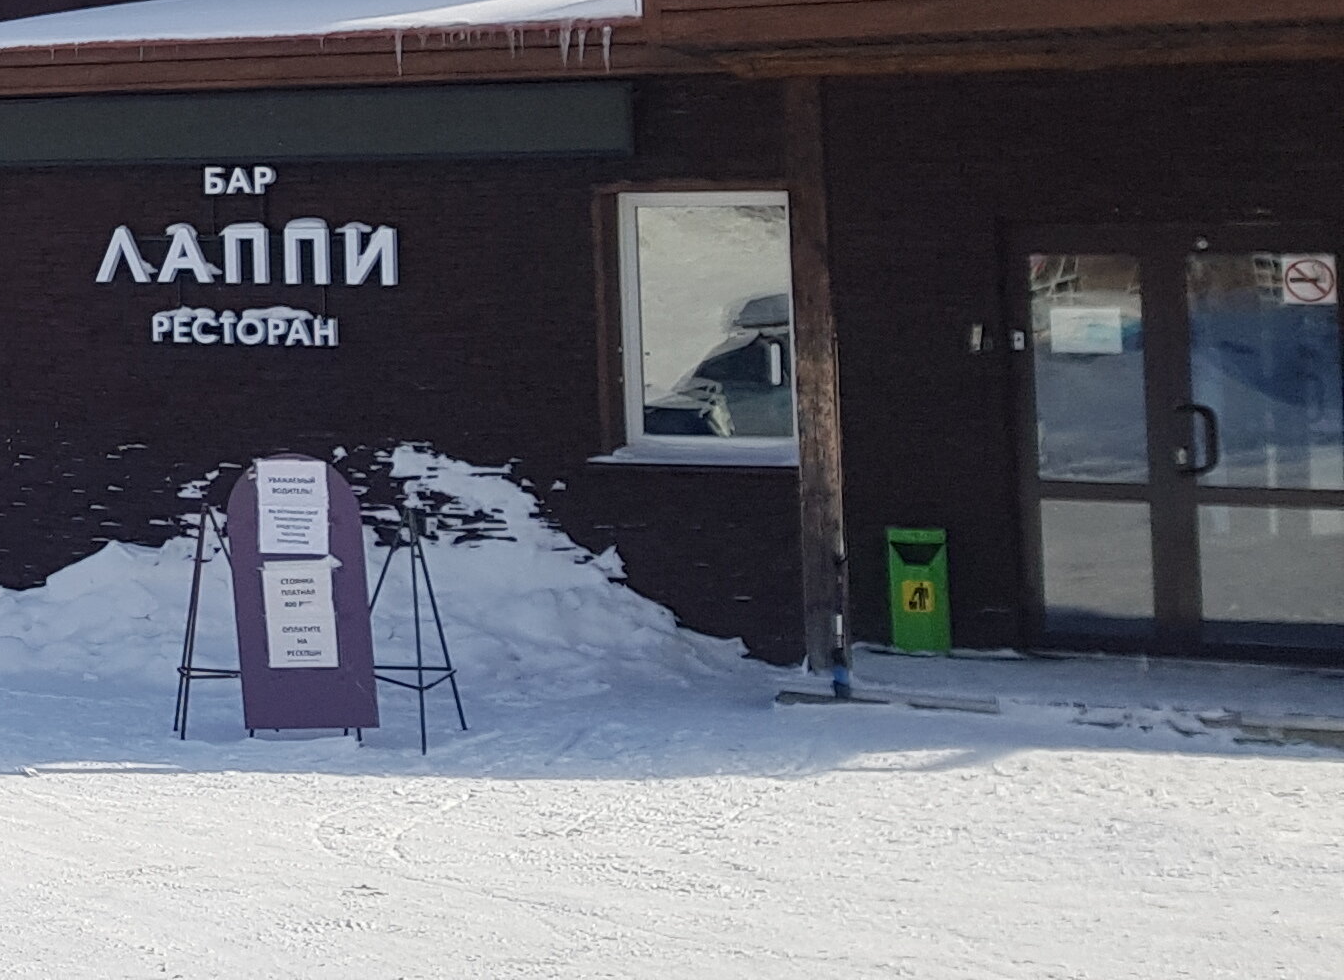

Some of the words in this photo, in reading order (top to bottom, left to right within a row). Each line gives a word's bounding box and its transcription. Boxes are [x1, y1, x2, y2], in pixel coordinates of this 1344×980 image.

[204, 166, 277, 195] БАР
[95, 223, 399, 286] ЛАППИ
[152, 314, 339, 347] РЕСТОРАН
